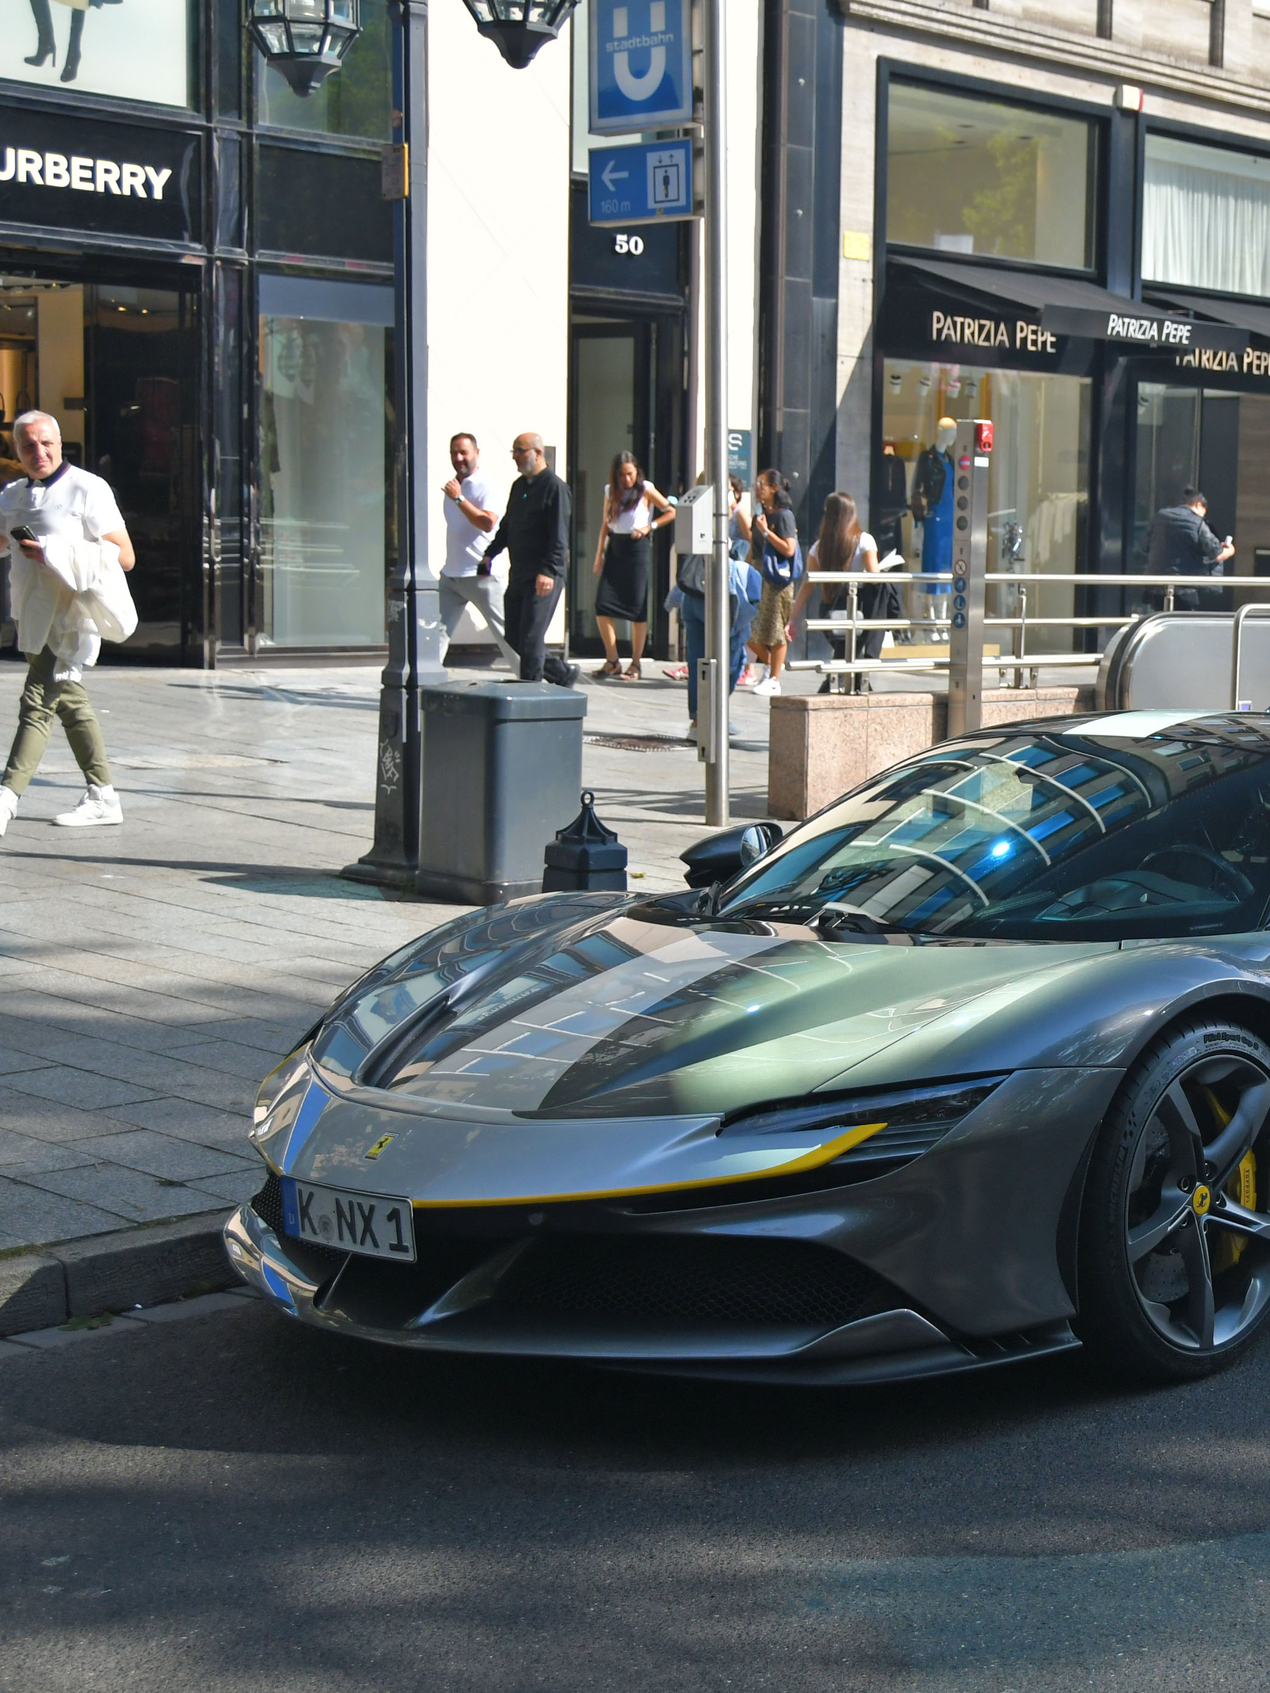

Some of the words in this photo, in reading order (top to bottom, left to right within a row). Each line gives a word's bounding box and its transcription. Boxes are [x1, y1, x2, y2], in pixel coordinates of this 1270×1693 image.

[606, 33, 674, 52] stadtbahn
[601, 199, 619, 213] 160
[621, 201, 631, 211] m
[614, 233, 645, 255] 50
[932, 310, 1009, 348] PATRIZIA
[1016, 320, 1057, 353] PEPE
[1107, 314, 1158, 341] PATRIZIA
[1162, 321, 1192, 344] PEPE
[298, 1188, 319, 1236] K
[335, 1197, 380, 1249] NX
[386, 1206, 409, 1253] 1
